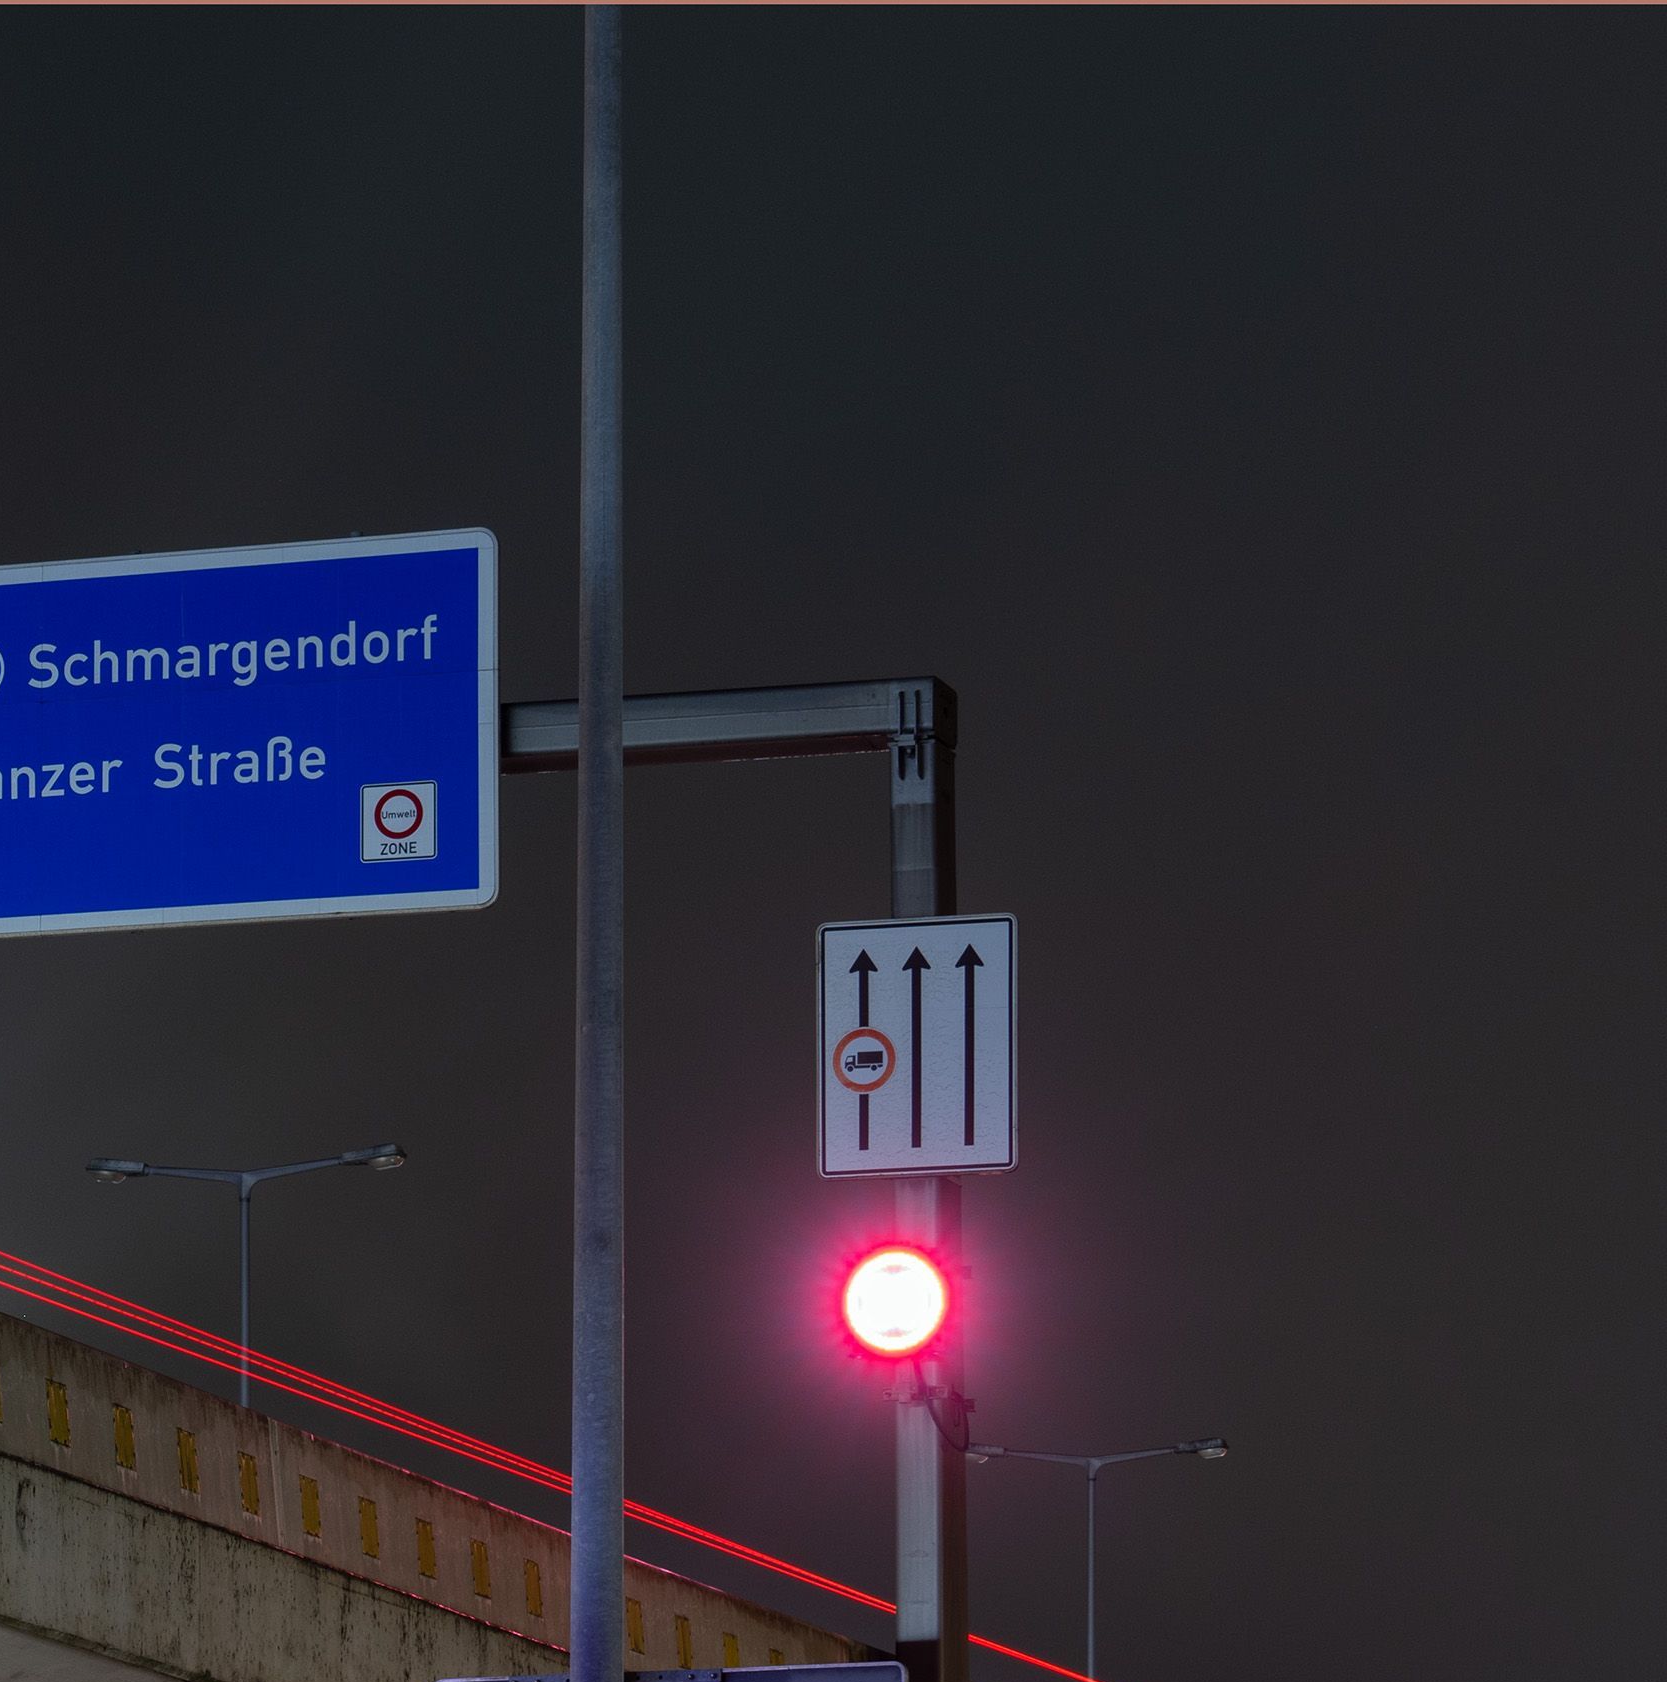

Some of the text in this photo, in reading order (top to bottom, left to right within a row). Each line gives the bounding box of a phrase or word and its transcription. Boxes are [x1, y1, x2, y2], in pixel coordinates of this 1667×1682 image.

[28, 614, 438, 689] Schmargendorf
[153, 736, 327, 789] Straße
[381, 809, 416, 820] Umwelt
[380, 841, 417, 856] ZONE
